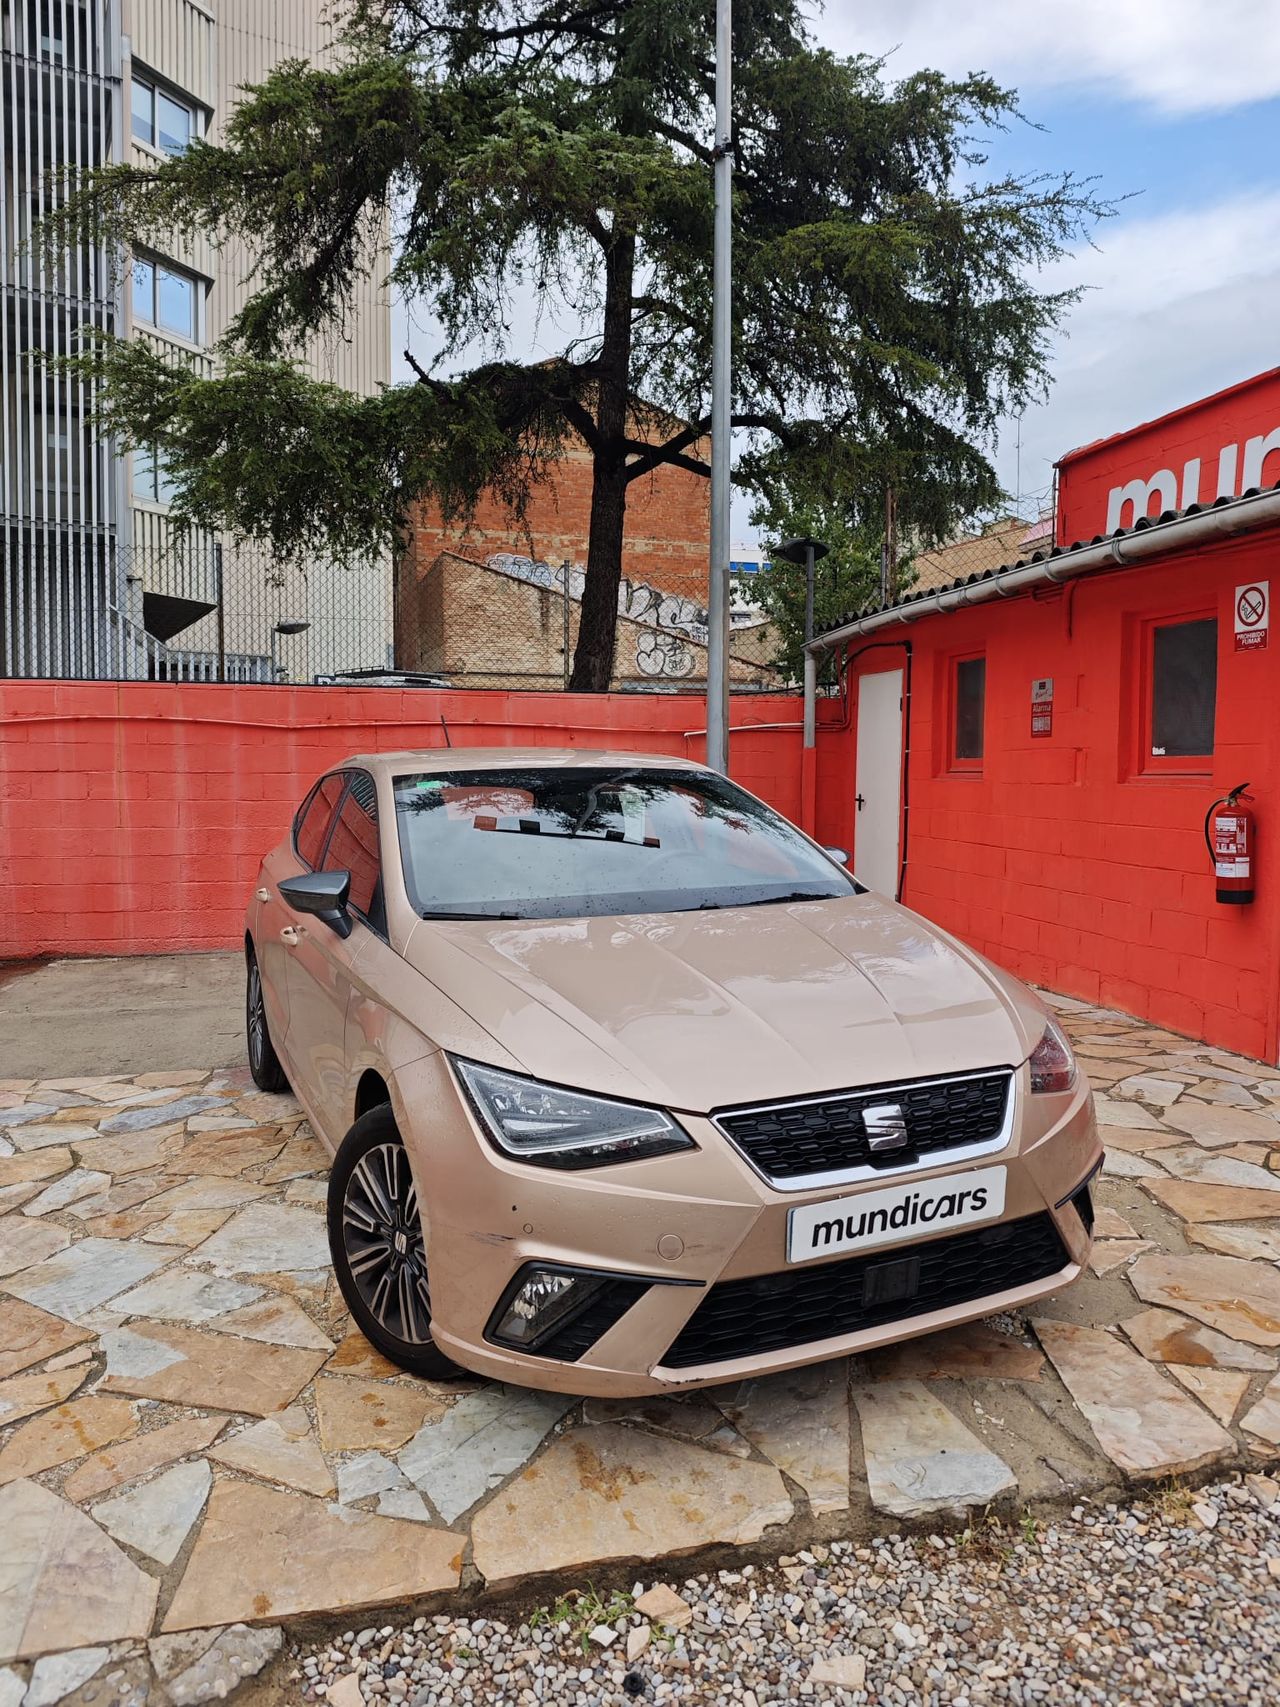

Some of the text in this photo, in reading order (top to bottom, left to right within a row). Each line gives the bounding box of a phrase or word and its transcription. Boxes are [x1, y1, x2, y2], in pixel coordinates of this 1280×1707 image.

[1236, 630, 1265, 640] PROHIBIDO
[1241, 637, 1261, 645] FUMAR
[811, 1187, 988, 1248] mundicars
